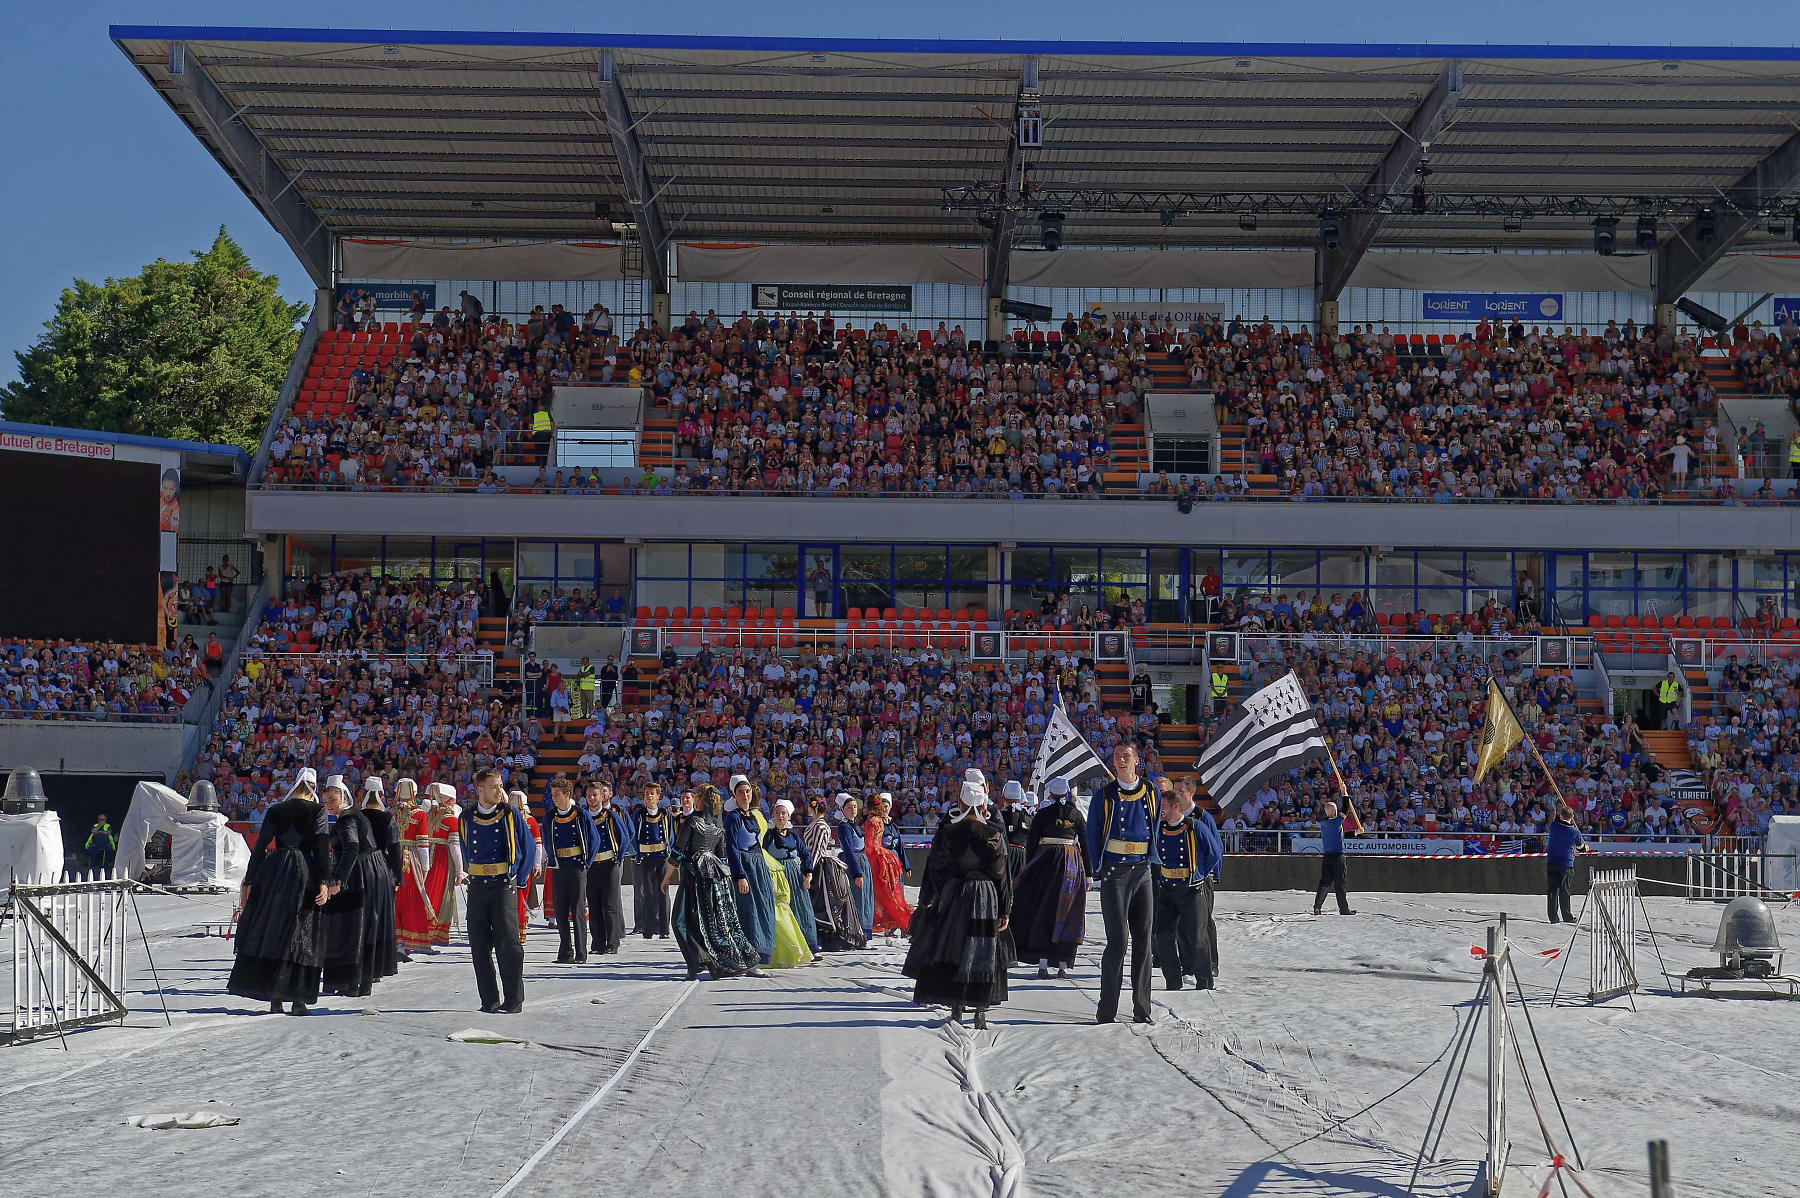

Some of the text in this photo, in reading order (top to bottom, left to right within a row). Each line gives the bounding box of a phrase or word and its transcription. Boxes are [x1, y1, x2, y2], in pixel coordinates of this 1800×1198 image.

[375, 290, 431, 300] morbiha.fr
[782, 290, 906, 302] Conseil régional de Bretagne
[36, 437, 52, 451] de
[54, 438, 111, 457] Bretagne
[1678, 790, 1710, 800] LORIENT
[1365, 843, 1427, 851] AUTOMOBILES
